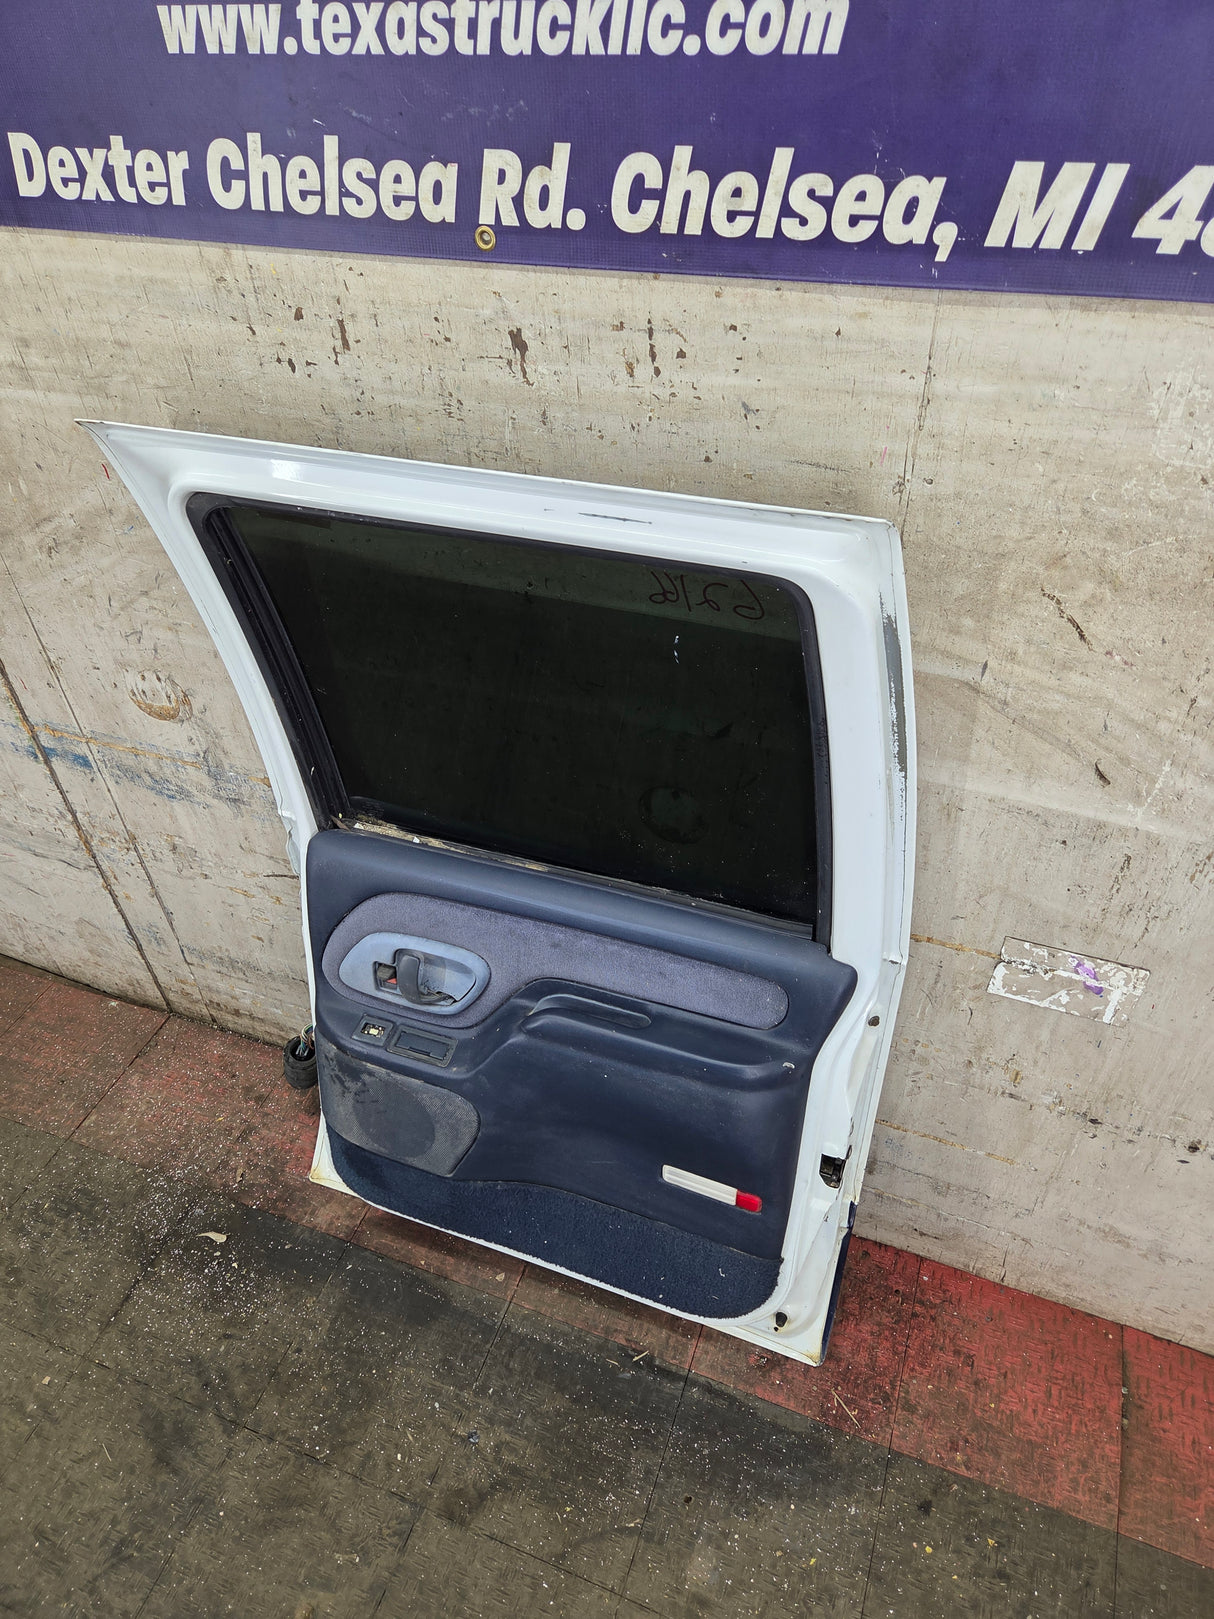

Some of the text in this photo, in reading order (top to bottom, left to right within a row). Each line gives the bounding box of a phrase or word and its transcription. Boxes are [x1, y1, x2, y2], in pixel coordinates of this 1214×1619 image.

[156, 0, 850, 57] www.texastruckllc.com
[7, 131, 1214, 262] Dexter Chelsea Rd. Chelsea, MI 4
